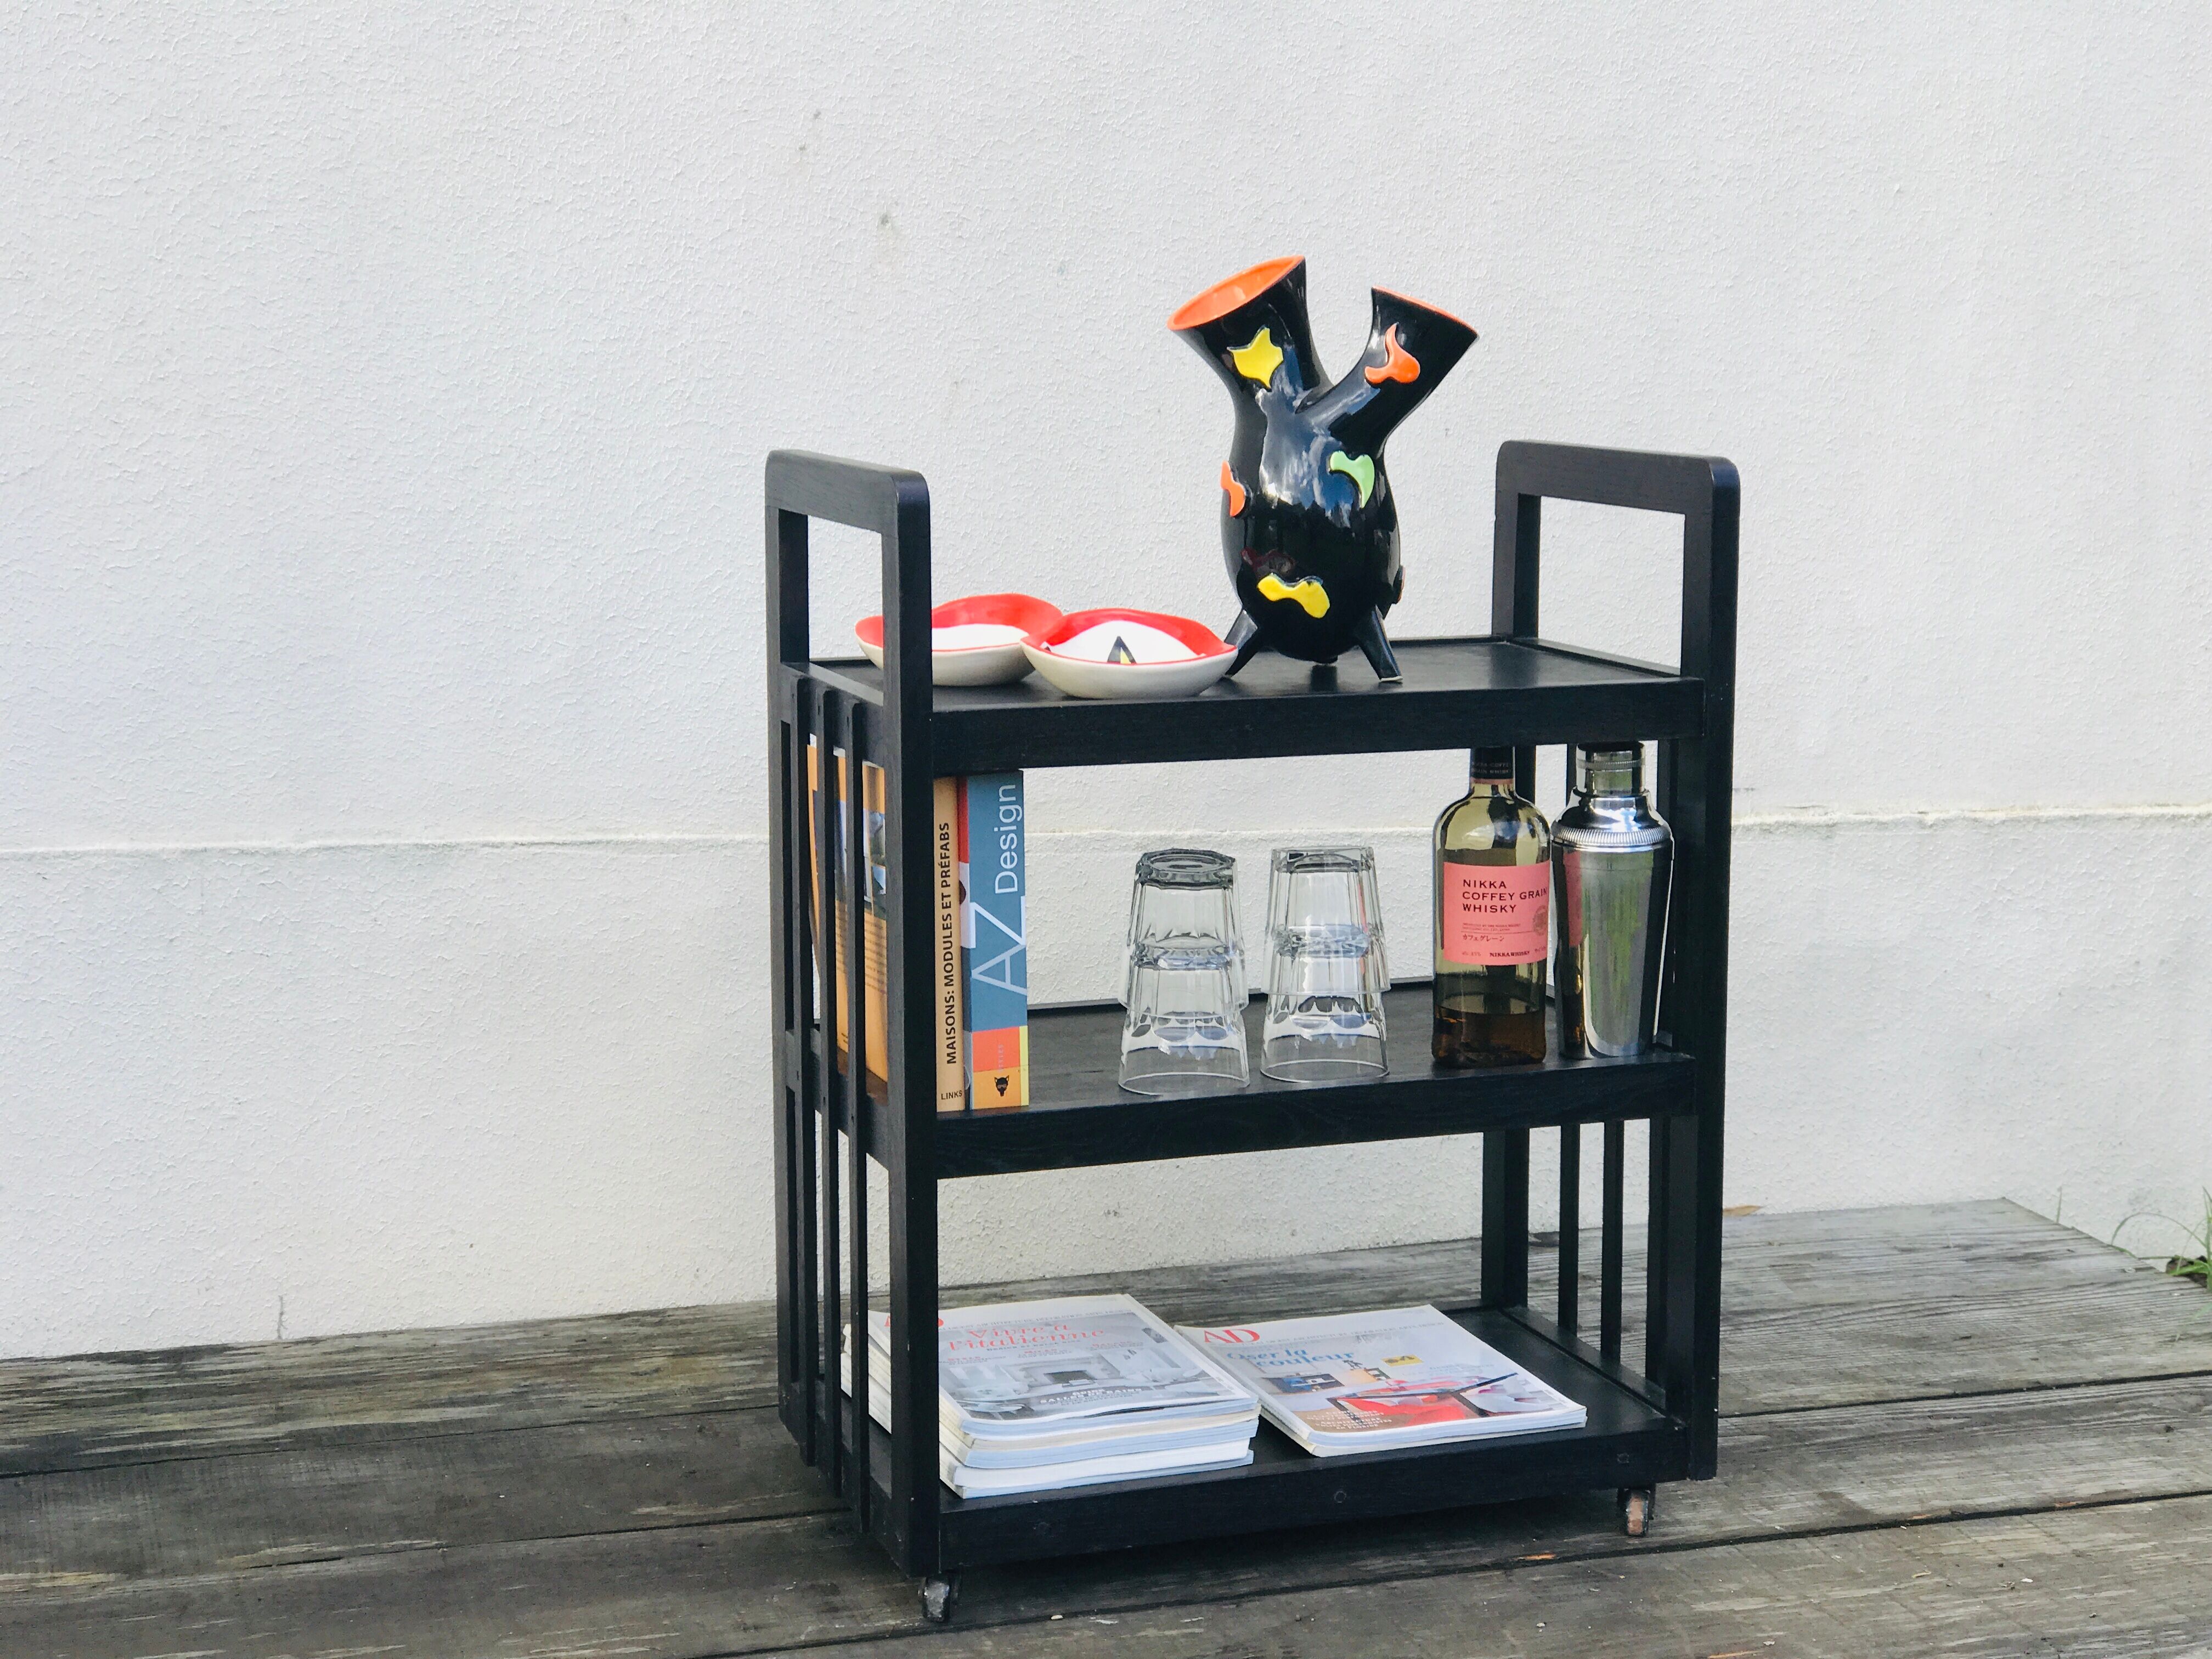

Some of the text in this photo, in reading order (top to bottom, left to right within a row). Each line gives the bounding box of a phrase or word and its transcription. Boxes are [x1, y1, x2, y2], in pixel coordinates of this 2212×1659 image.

[994, 785, 1023, 894] Design
[1463, 879, 1507, 889] NIKKA
[1462, 887, 1547, 901] COFFEY GRAIN
[1463, 903, 1517, 913] WHISKY
[938, 822, 957, 1064] MAISONS: MODULES ET PRÉFABS
[940, 1090, 963, 1100] LINKS
[969, 1327, 1045, 1339] Vivre
[1203, 1328, 1260, 1343] AD
[1226, 1352, 1279, 1360] Oser
[1256, 1352, 1355, 1367] couleur
